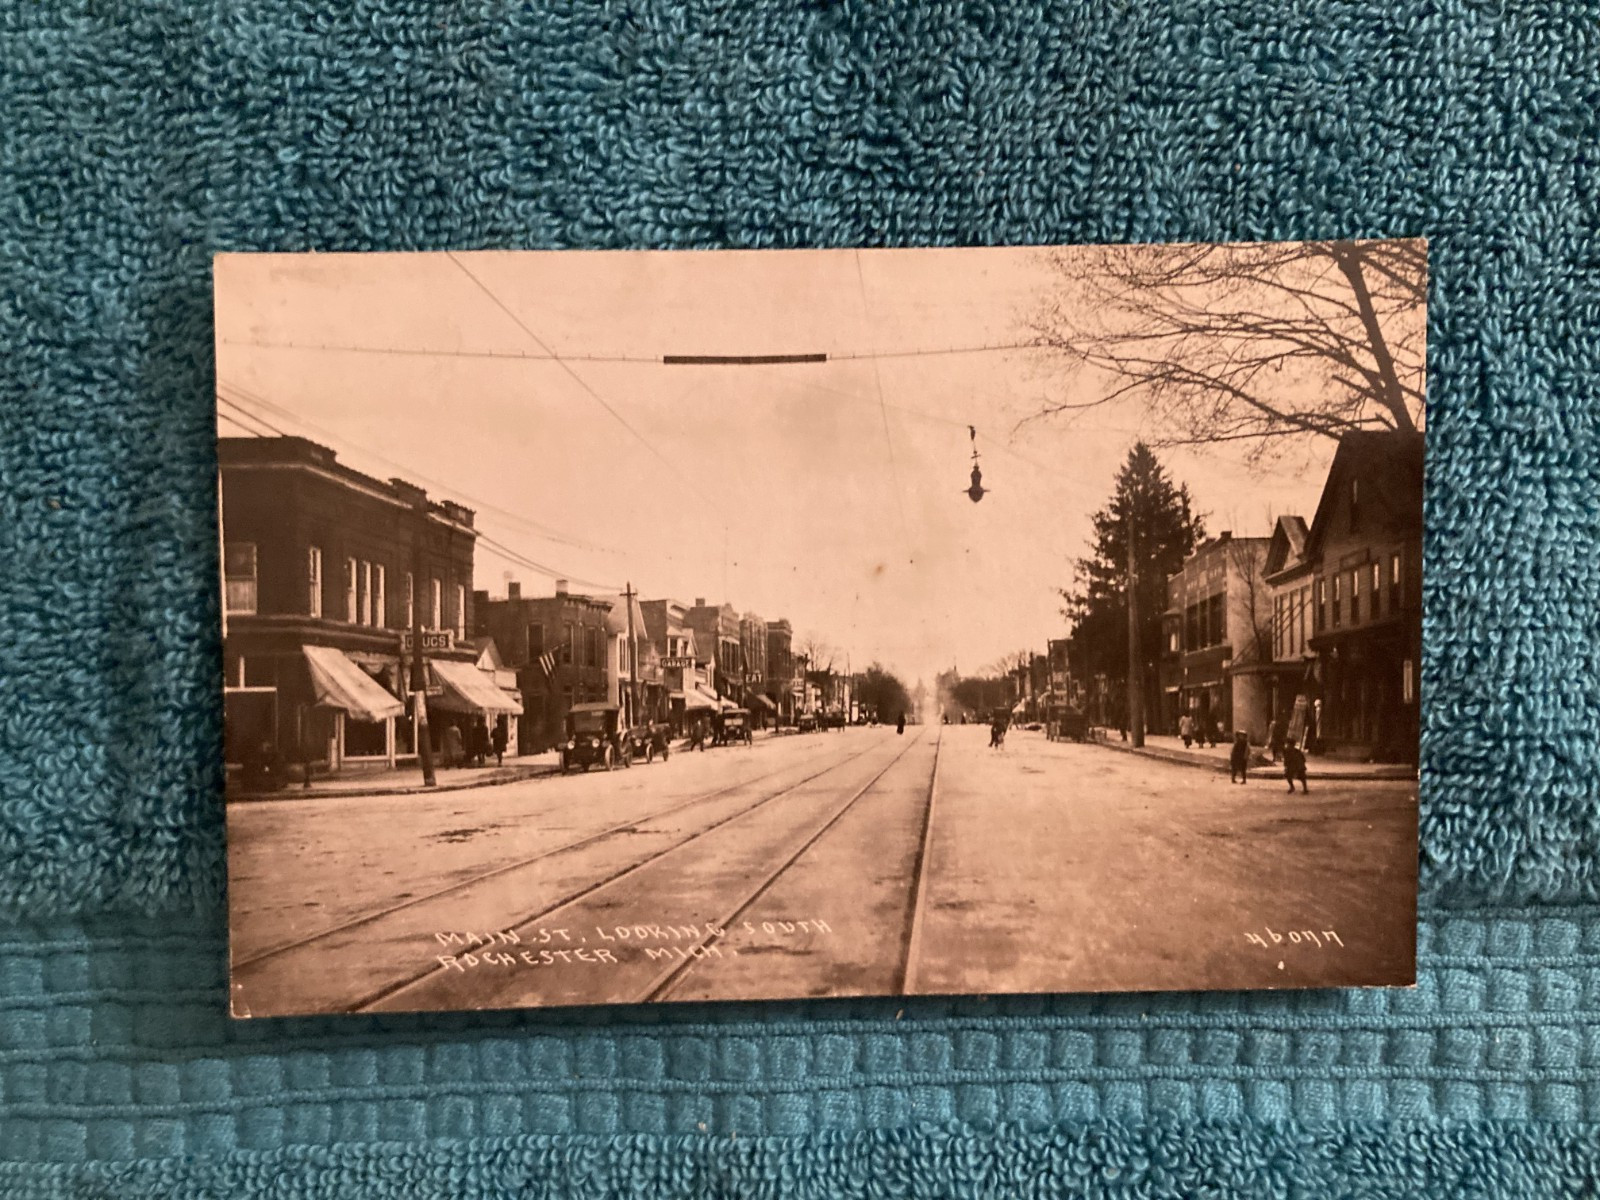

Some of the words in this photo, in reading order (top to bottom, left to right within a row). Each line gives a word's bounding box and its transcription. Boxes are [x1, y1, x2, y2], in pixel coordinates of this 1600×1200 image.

[661, 659, 690, 669] GARAGE
[745, 674, 762, 683] EAT
[434, 929, 521, 947] MAIN
[595, 921, 726, 941] LOOKING
[742, 919, 833, 935] SOUTH
[436, 947, 618, 972] ROCHESTER
